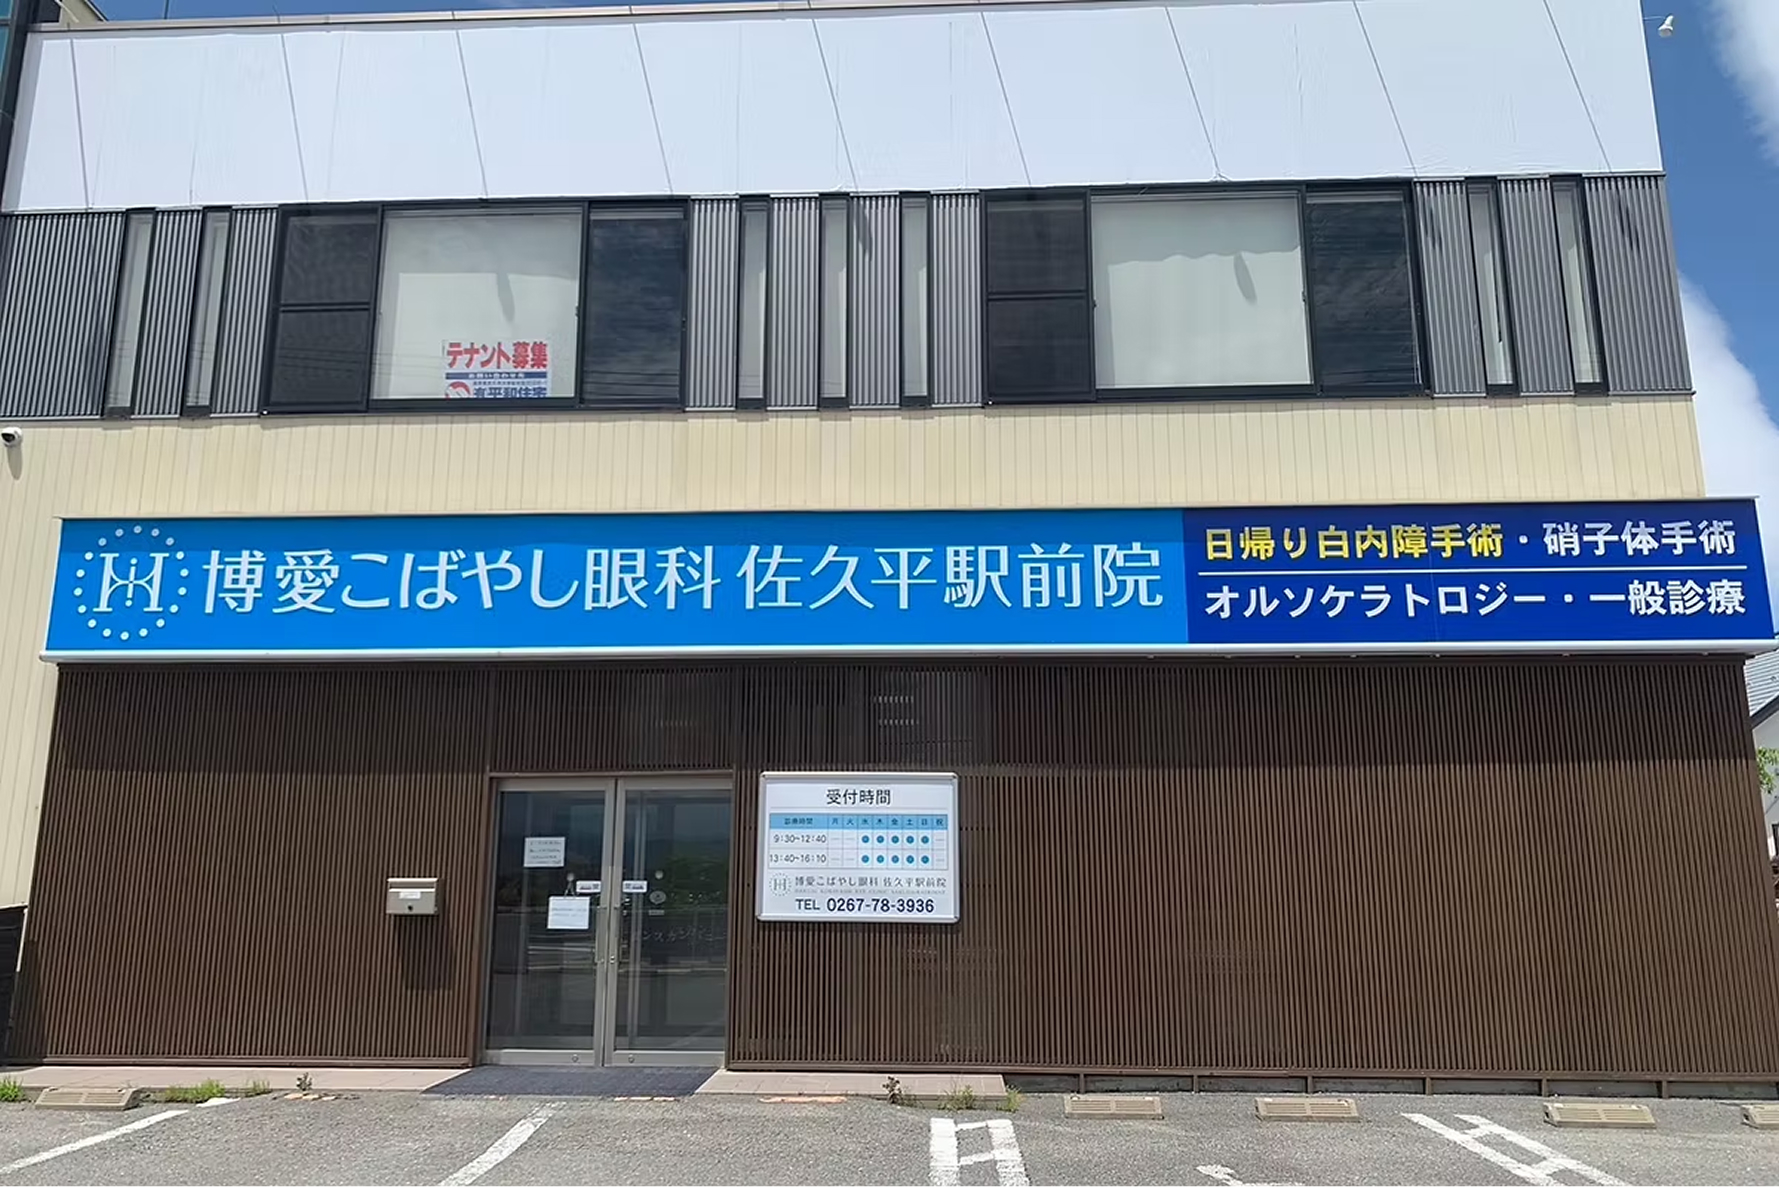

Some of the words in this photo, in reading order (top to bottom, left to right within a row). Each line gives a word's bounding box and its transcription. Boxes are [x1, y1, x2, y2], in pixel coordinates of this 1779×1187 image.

[446, 341, 547, 369] テナント募集
[203, 546, 721, 613] 博愛こばやし眼科
[737, 542, 1163, 609] 佐久平駅前院
[826, 788, 891, 806] 受付時間
[795, 899, 821, 911] TEL
[826, 898, 935, 913] 0267-78-3936
